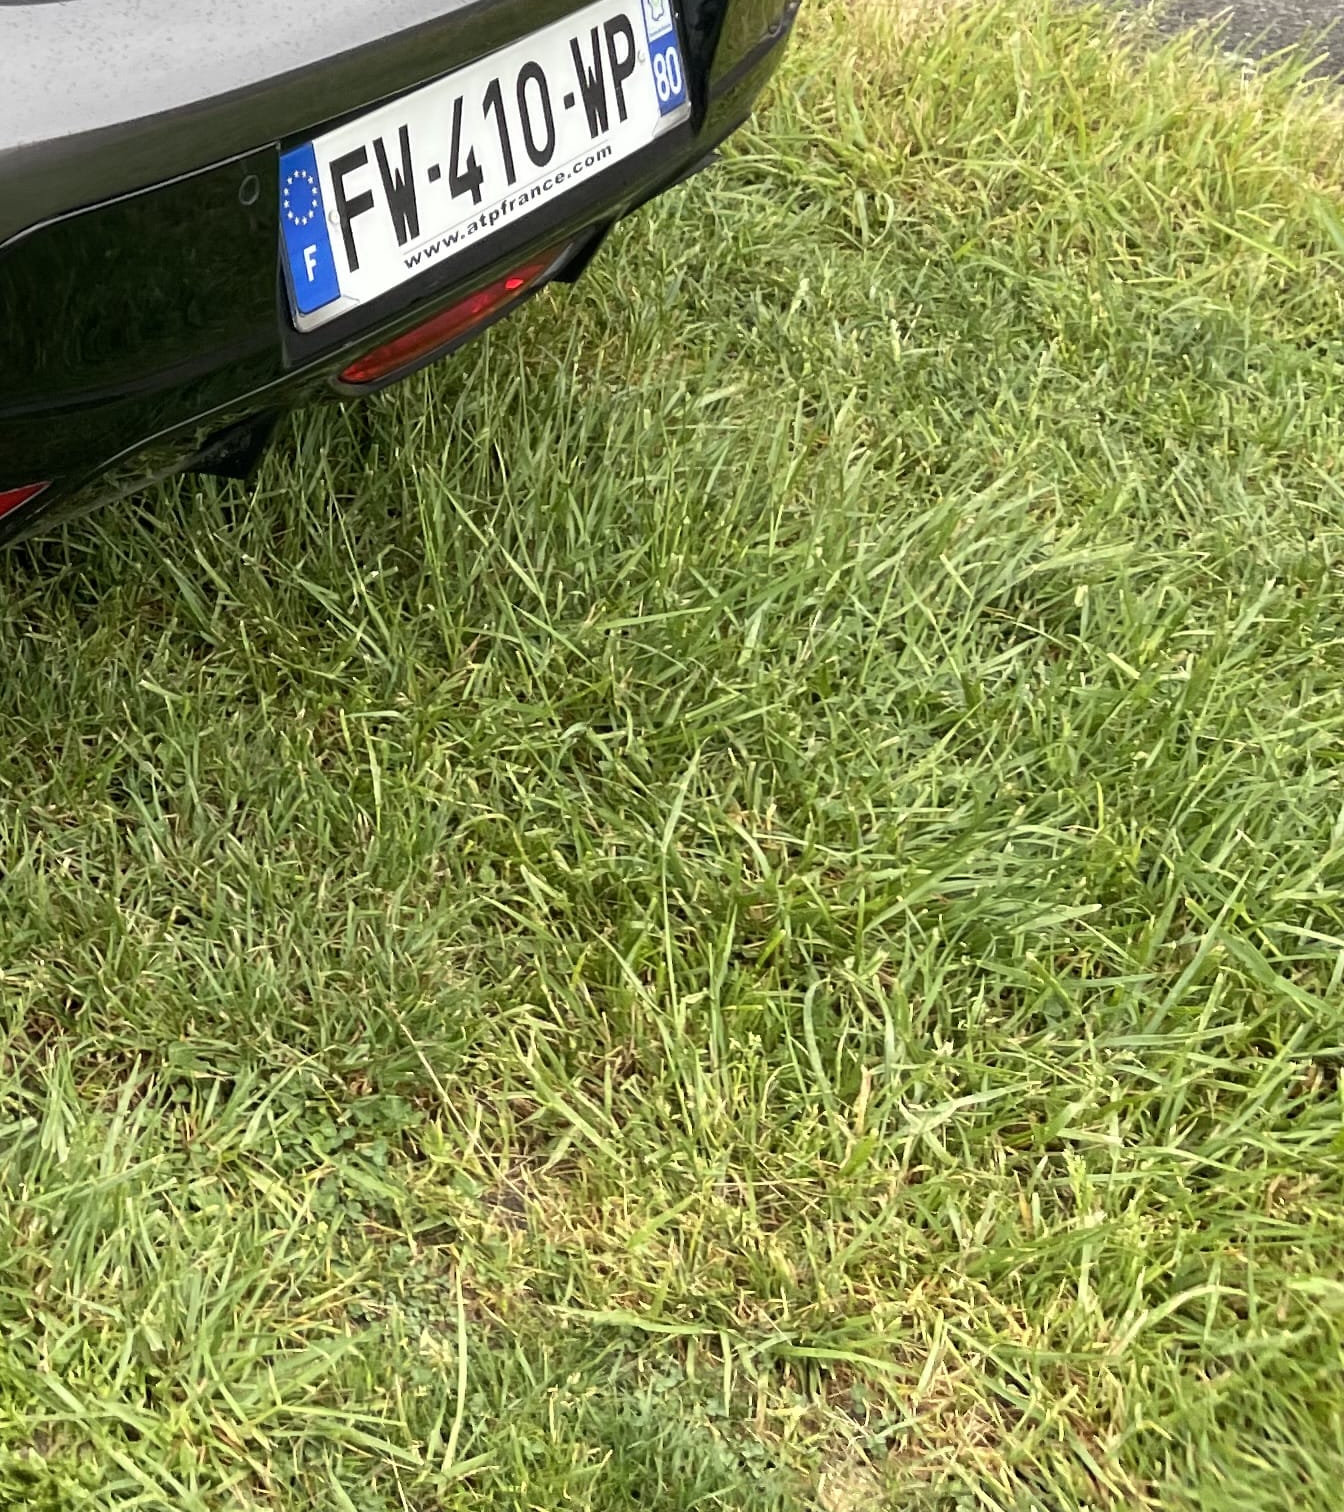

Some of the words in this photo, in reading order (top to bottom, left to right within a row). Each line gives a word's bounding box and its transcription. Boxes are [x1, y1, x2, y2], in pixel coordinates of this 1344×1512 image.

[652, 45, 683, 102] 80
[328, 12, 636, 273] FW-410-WP
[402, 142, 614, 271] www.atpfrance.com
[303, 244, 318, 282] F
